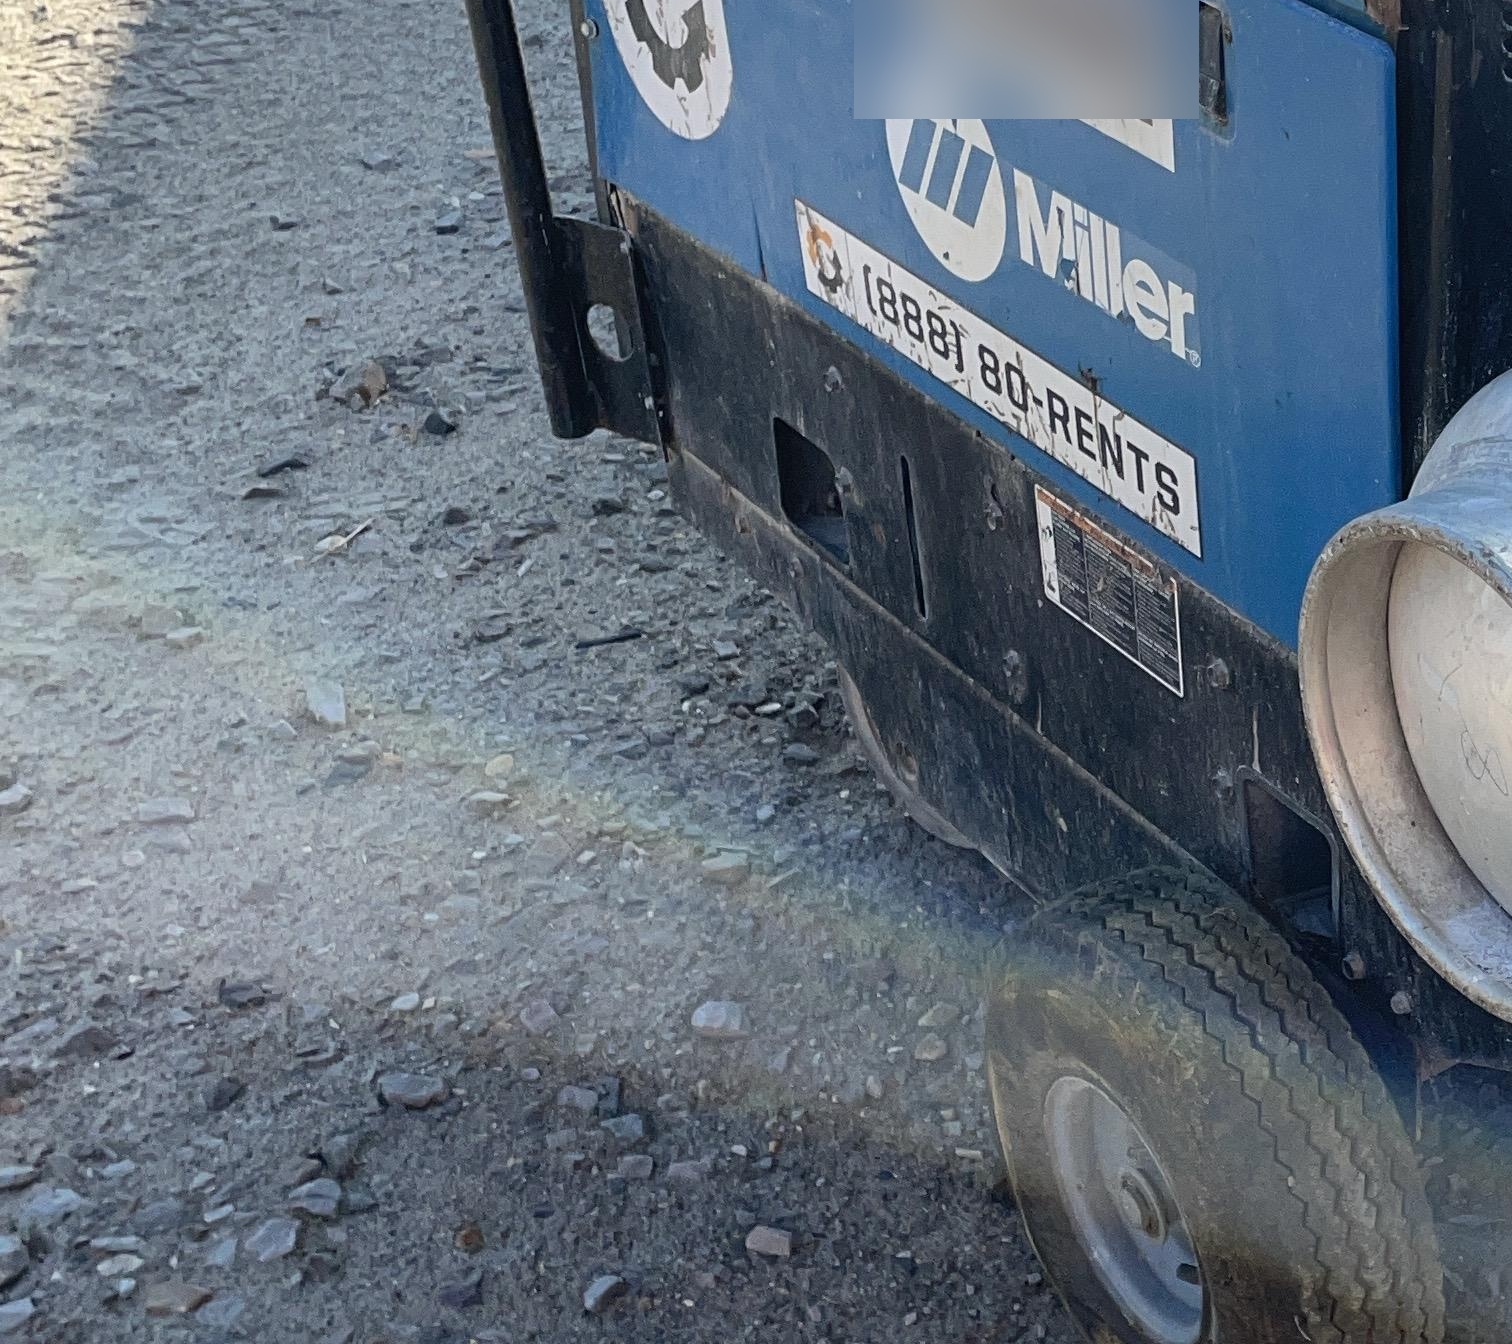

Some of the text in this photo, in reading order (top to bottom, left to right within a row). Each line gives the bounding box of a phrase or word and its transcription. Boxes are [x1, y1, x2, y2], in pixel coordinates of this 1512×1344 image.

[1013, 167, 1196, 361] Miller
[862, 263, 1183, 518] (888) 80-RENTS
